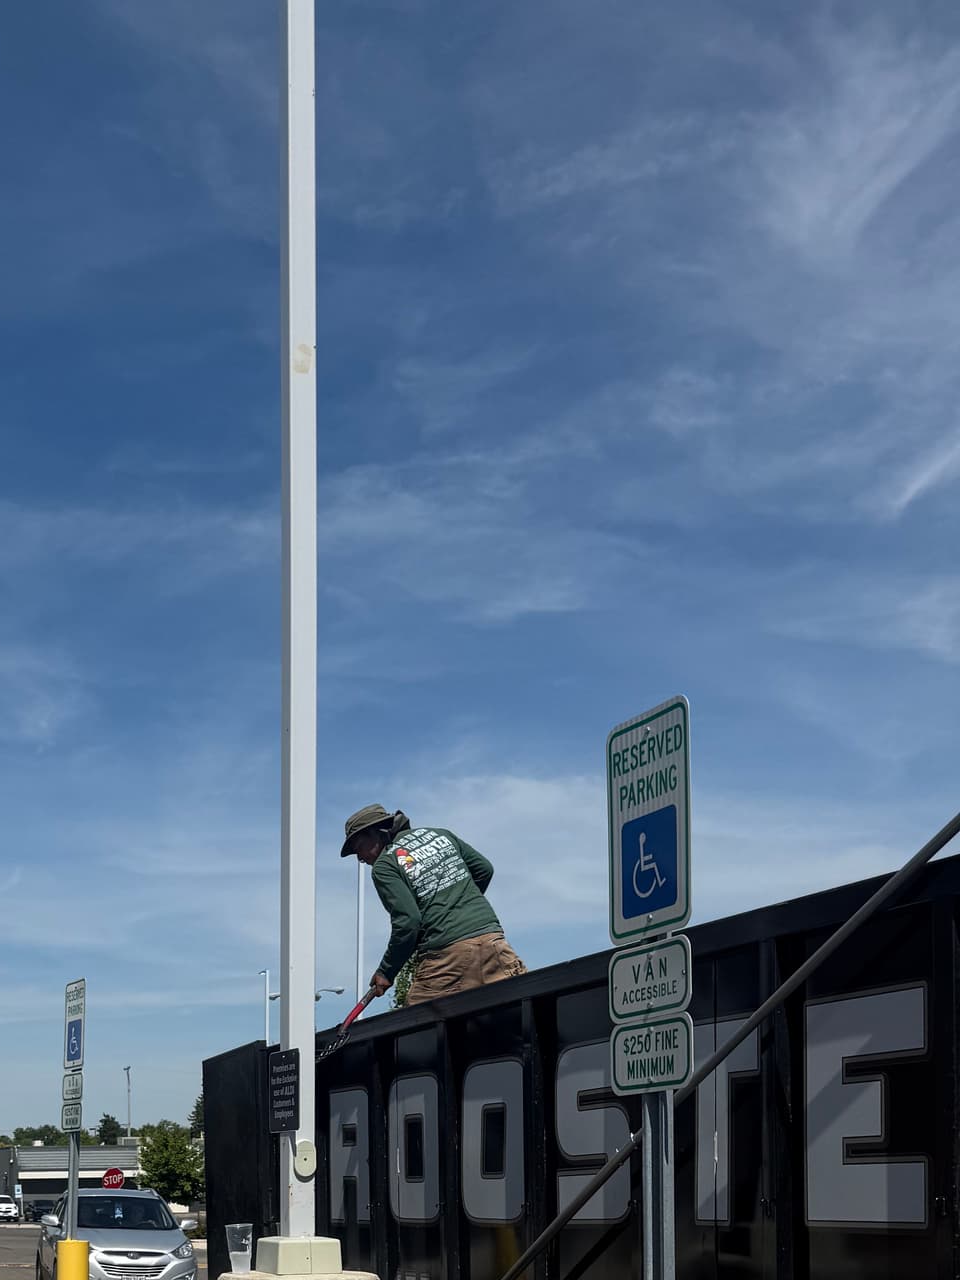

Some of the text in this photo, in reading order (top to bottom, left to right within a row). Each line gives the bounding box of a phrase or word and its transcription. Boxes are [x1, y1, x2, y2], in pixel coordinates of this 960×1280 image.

[612, 724, 682, 778] RESERVED
[619, 764, 678, 812] PARKING
[409, 835, 453, 862] ROOSTER
[632, 957, 668, 985] VAN
[622, 980, 678, 1005] ACCESSIBLE
[623, 1028, 679, 1056] $250 FINE
[627, 1054, 675, 1081] MINIMUM
[103, 1173, 123, 1186] STOP
